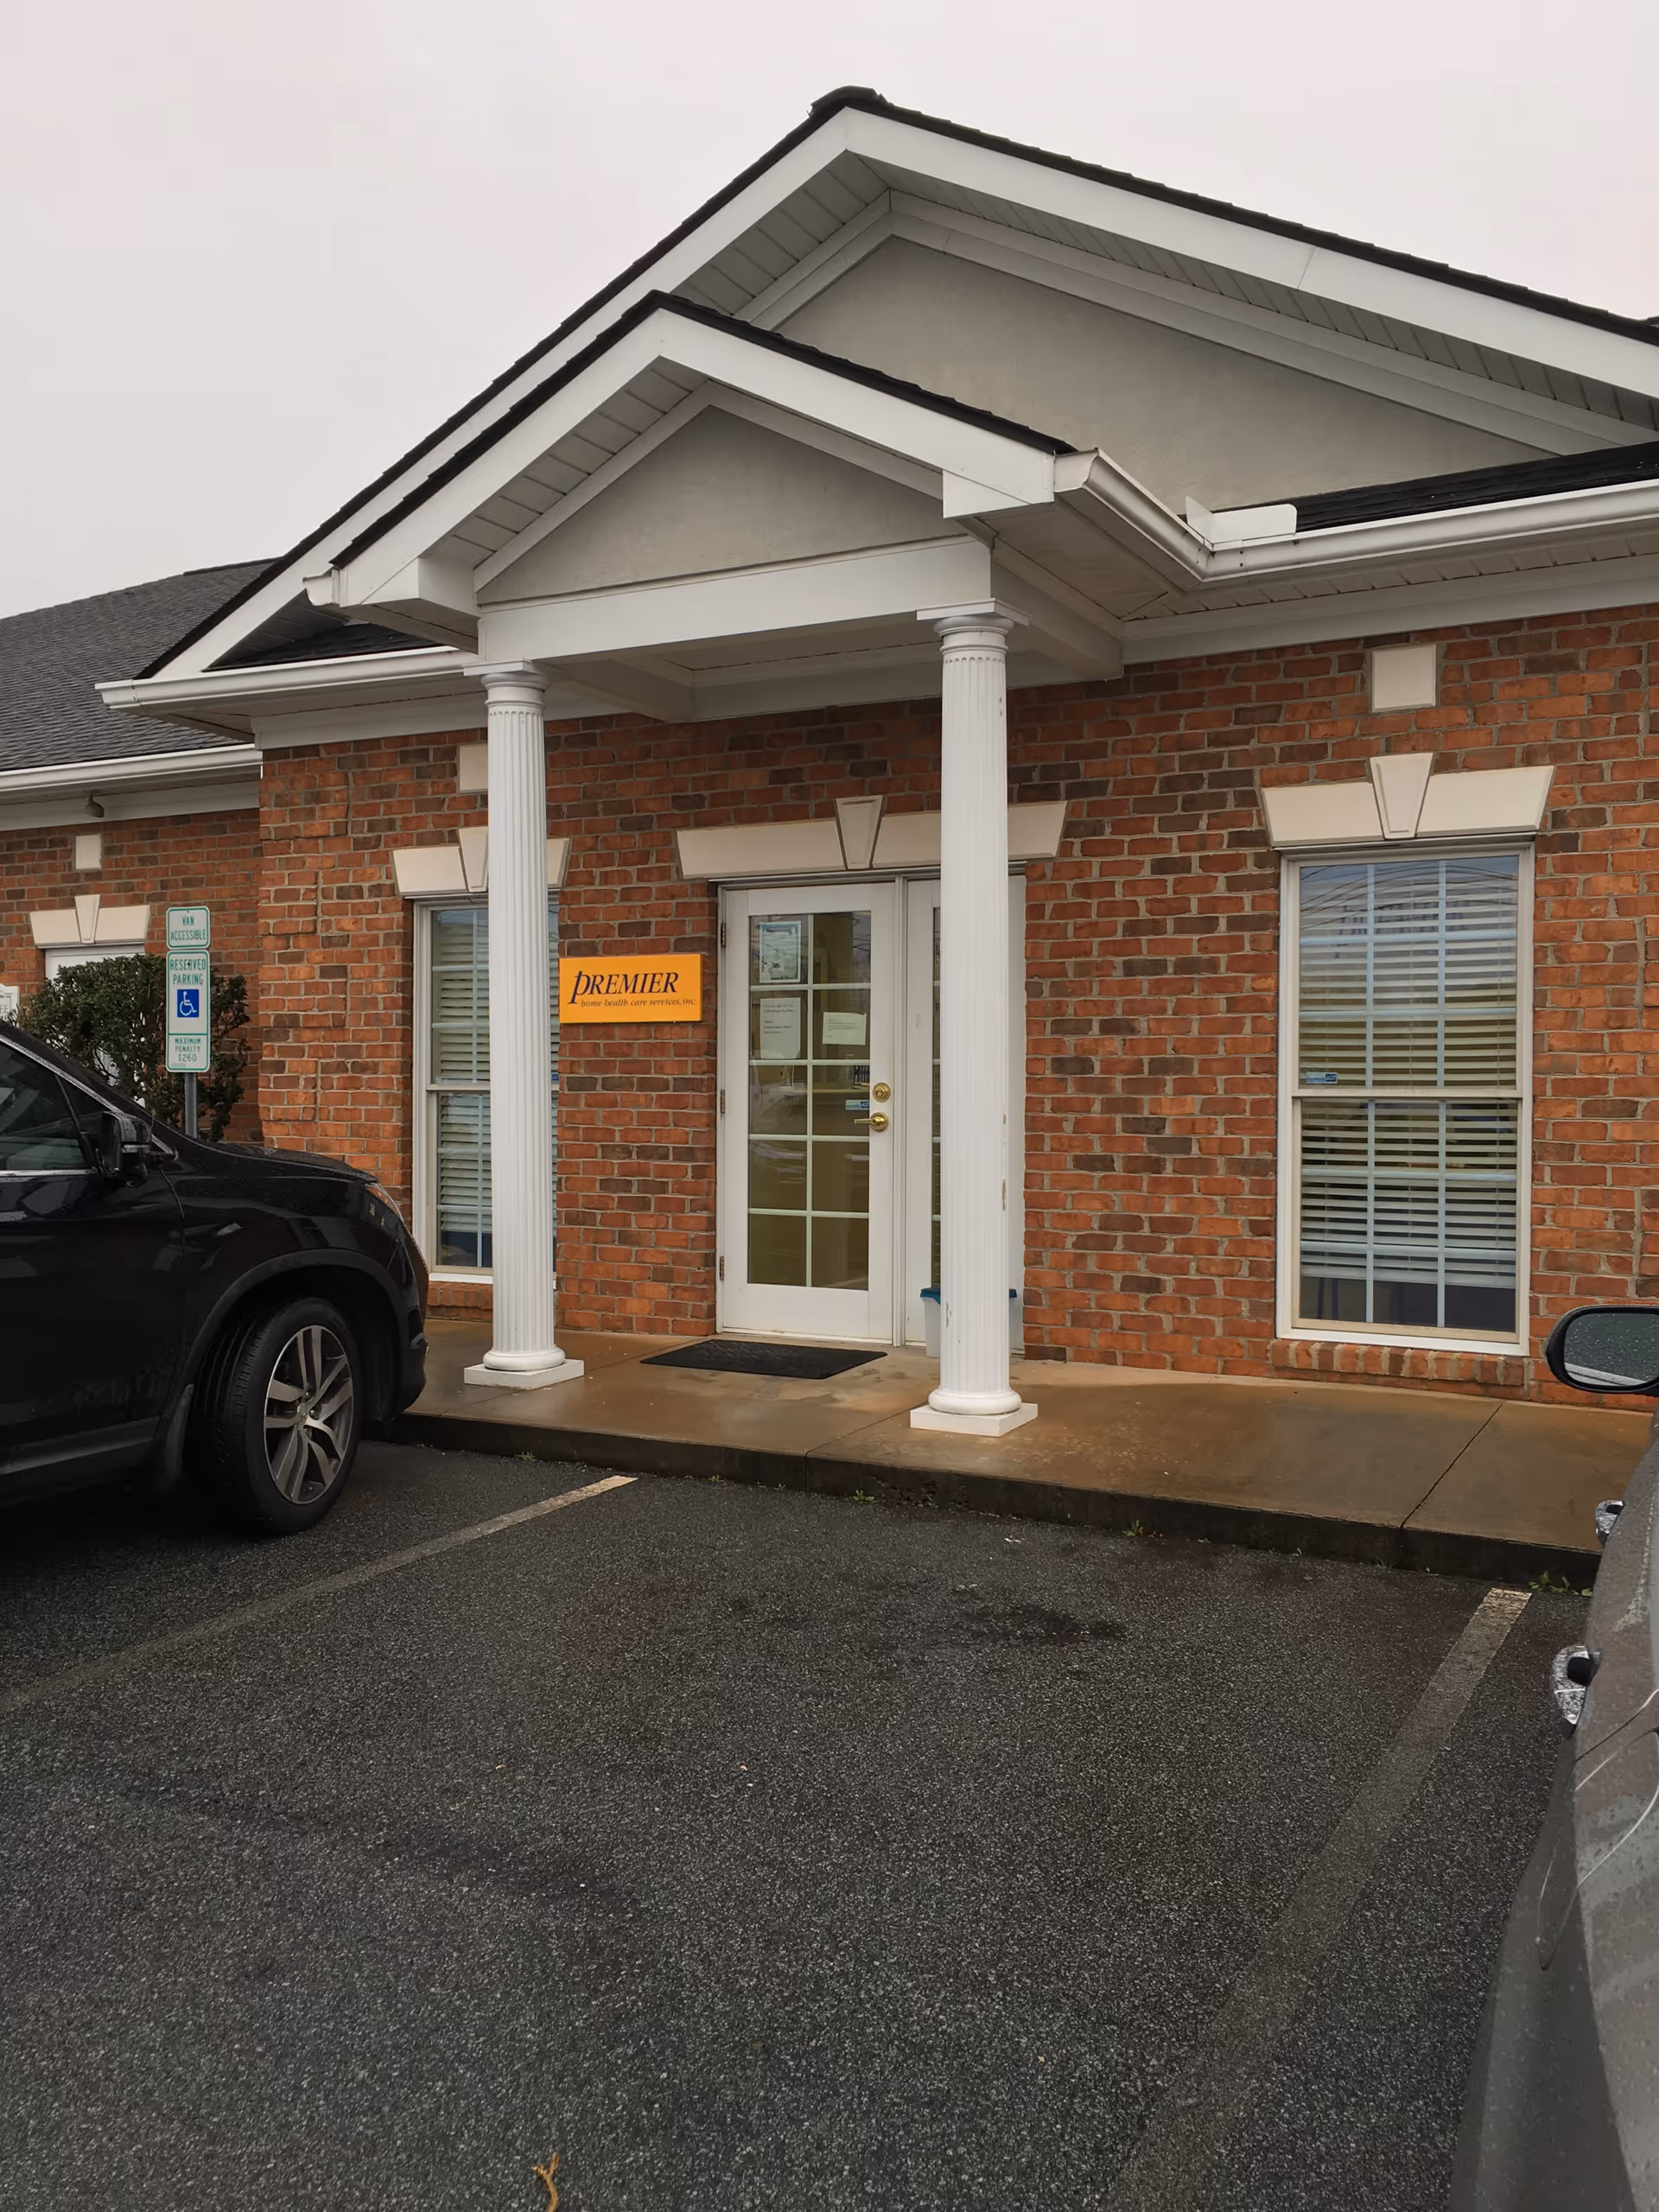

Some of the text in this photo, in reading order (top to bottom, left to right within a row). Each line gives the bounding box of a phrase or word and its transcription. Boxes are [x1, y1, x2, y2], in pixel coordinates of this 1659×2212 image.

[182, 916, 194, 925] VAN
[170, 930, 207, 941] ACCESSIBLE
[169, 958, 207, 970] RESERVED
[173, 973, 203, 985] PARKING
[568, 970, 679, 1005] PREMIER
[581, 999, 602, 1007] home
[605, 998, 628, 1007] health
